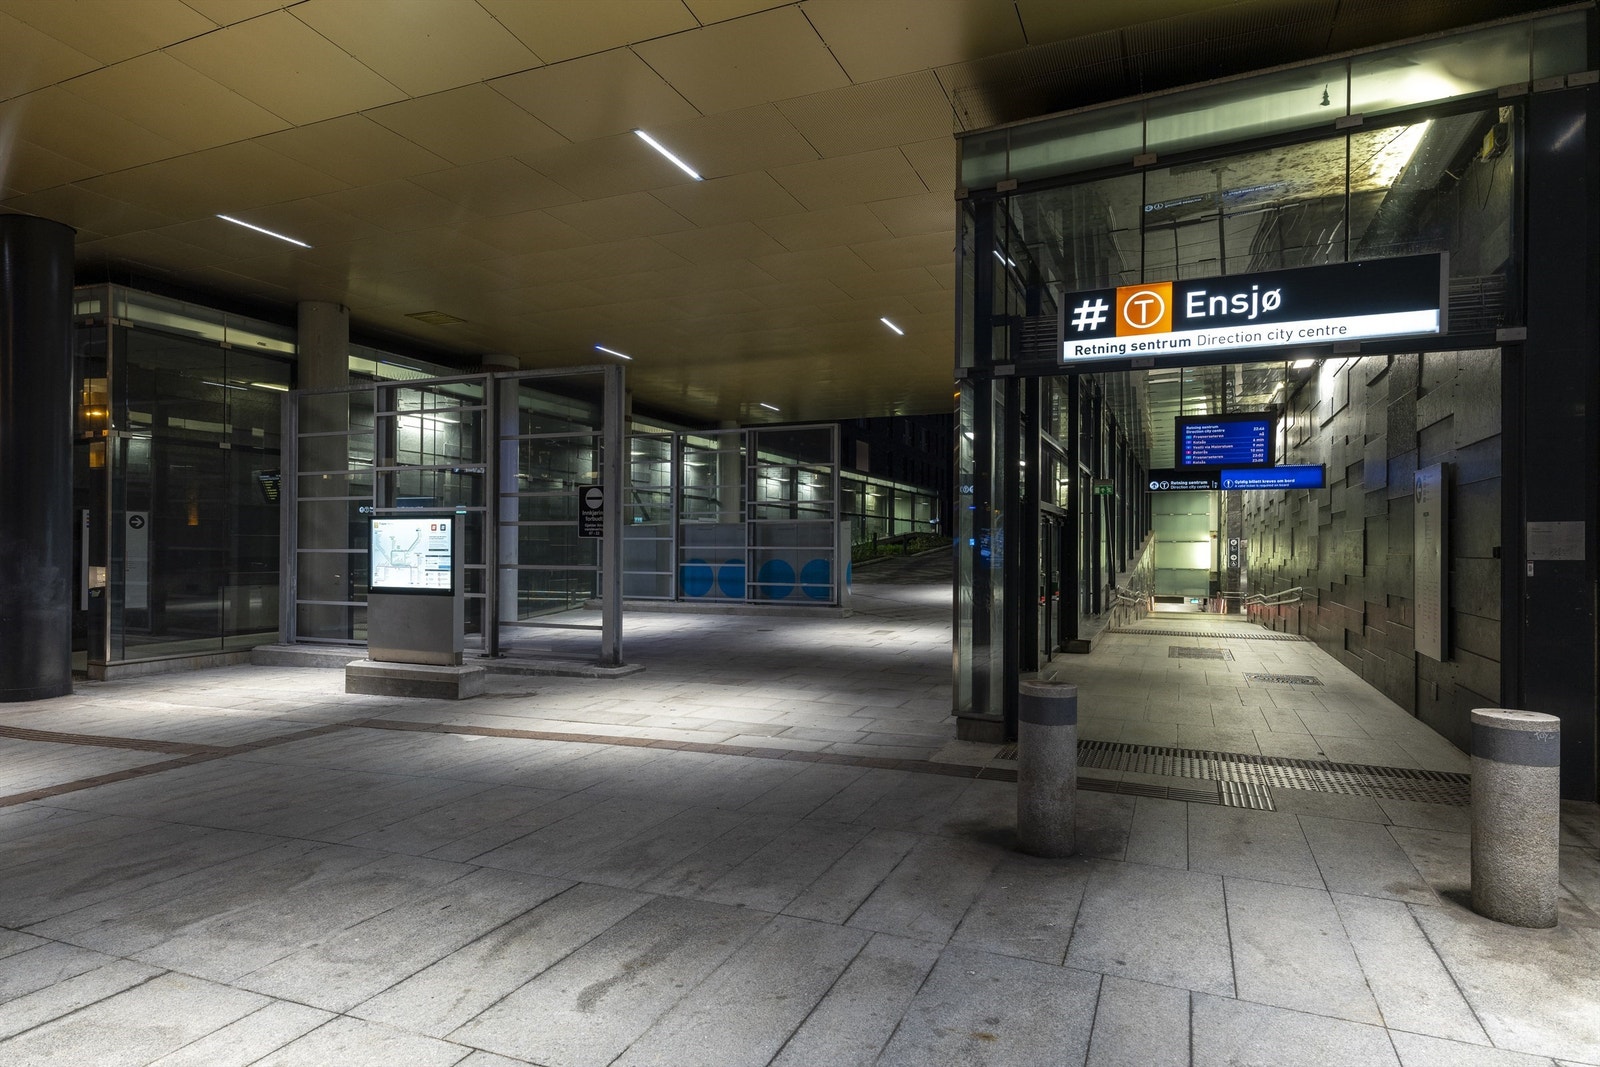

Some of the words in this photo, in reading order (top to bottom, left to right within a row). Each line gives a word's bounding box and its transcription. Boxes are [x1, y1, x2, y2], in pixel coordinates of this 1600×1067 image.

[1185, 285, 1282, 320] Ensjø
[1074, 341, 1127, 357] Retning
[1130, 336, 1192, 352] sentrum
[1197, 329, 1262, 347] Direction
[1267, 327, 1293, 343] city
[1298, 324, 1348, 339] centre
